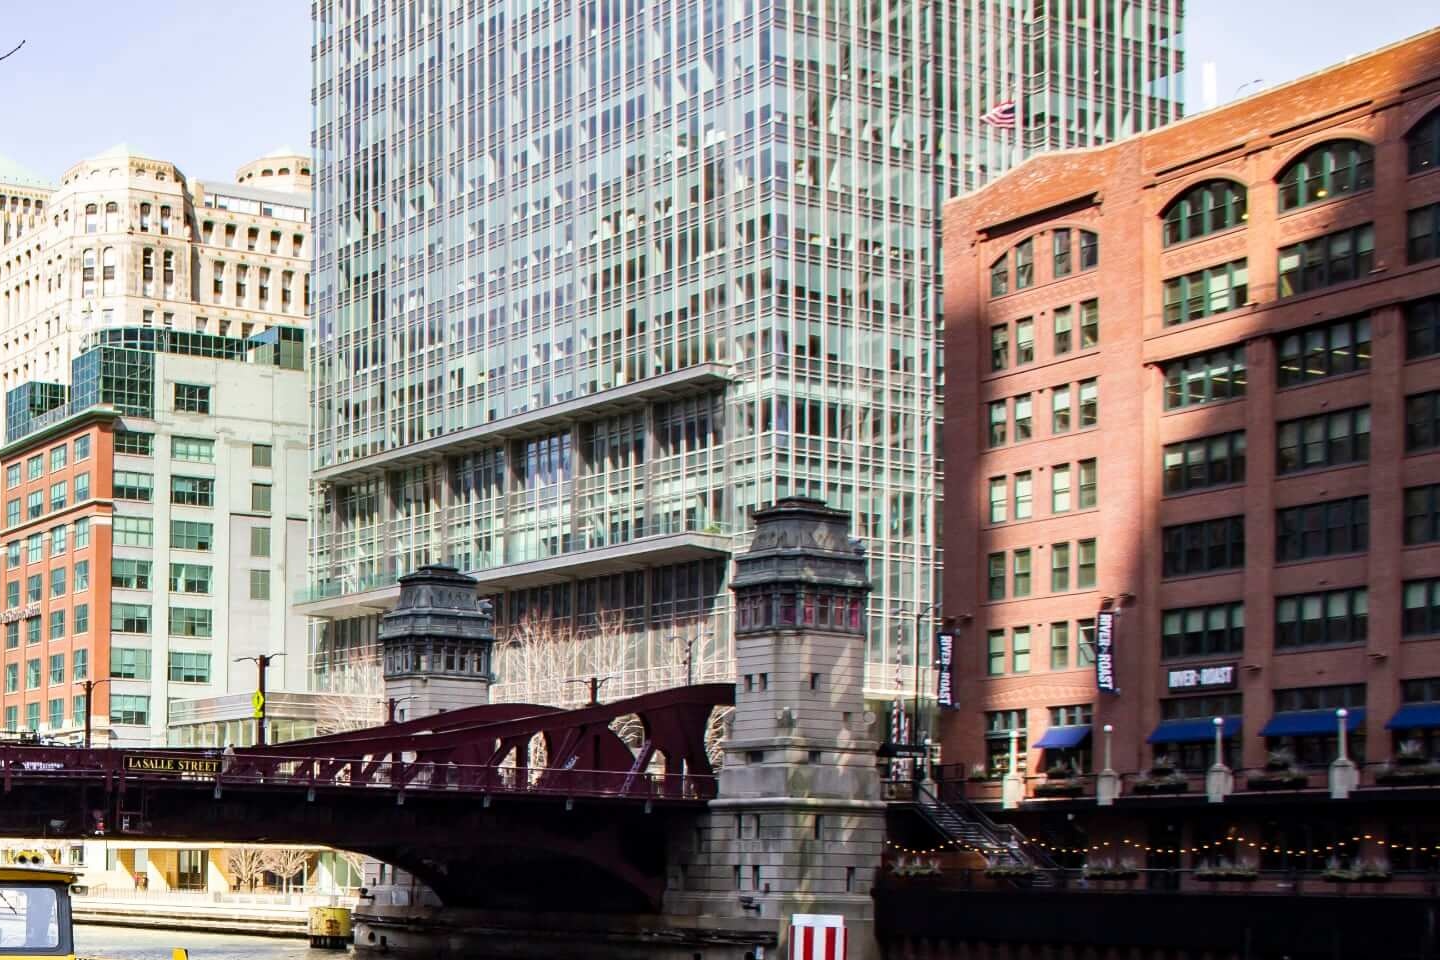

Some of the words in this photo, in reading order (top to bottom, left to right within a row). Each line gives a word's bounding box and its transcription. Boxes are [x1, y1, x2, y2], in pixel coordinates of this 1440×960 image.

[1098, 614, 1113, 647] RIVER
[939, 635, 953, 665] RIVER
[1097, 654, 1113, 690] ROAST
[938, 672, 951, 706] ROAST
[177, 759, 218, 772] STREET
